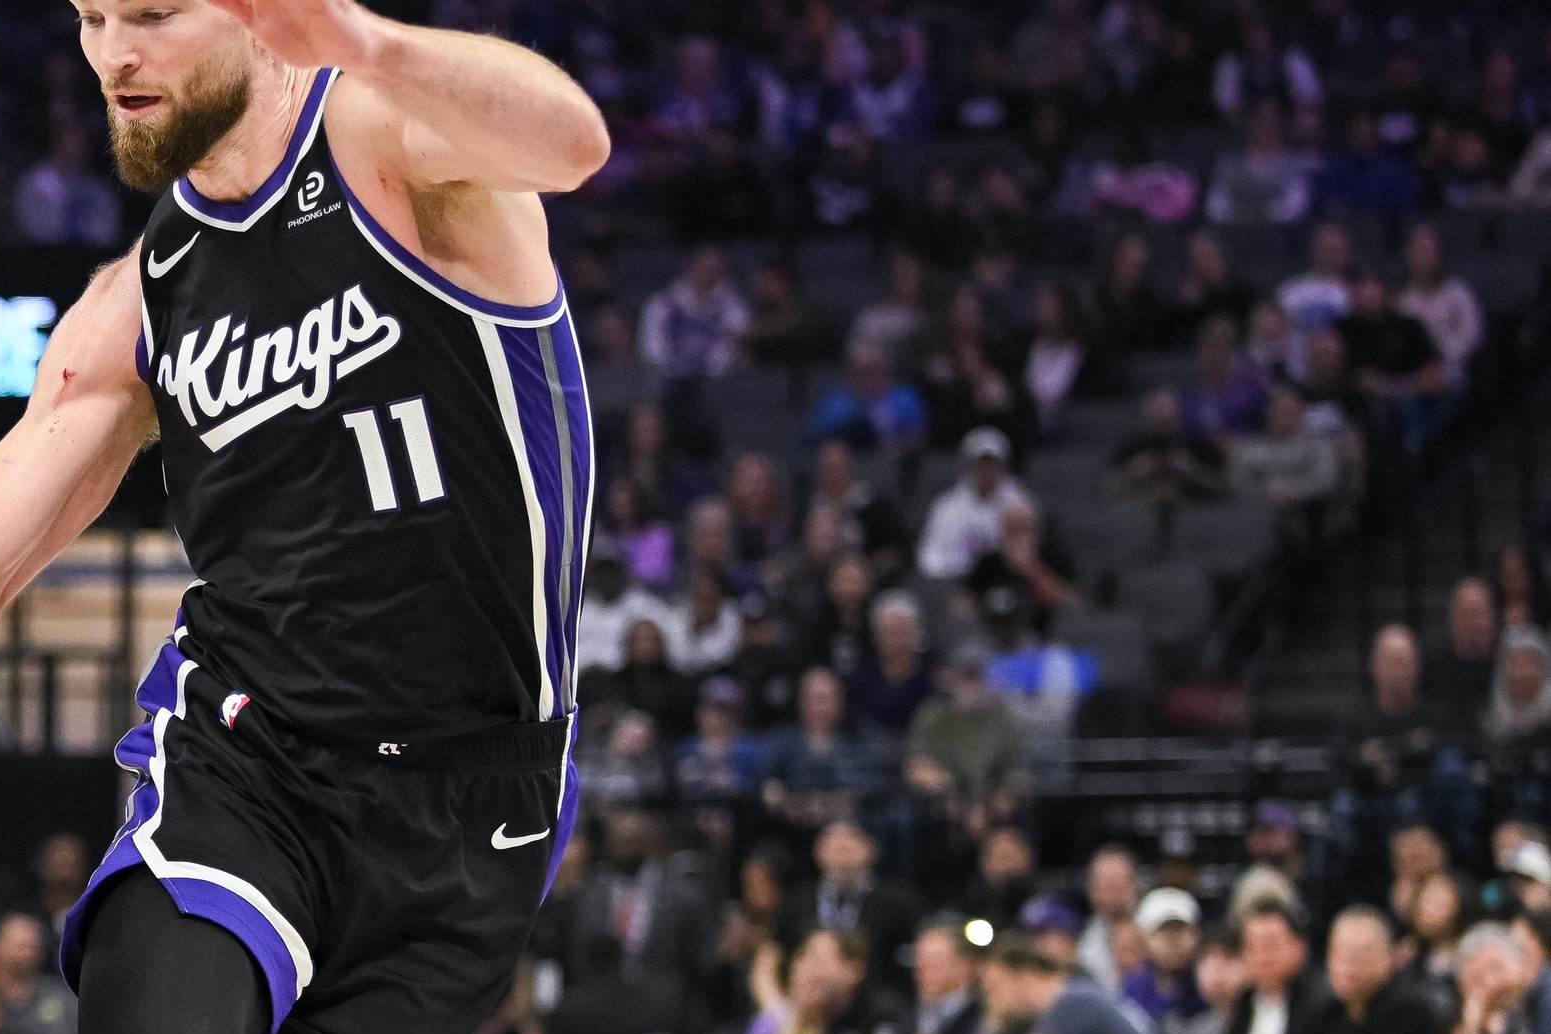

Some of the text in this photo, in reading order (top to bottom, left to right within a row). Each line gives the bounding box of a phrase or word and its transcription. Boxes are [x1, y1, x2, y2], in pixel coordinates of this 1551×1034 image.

[287, 201, 342, 229] PHOONG LAW
[156, 283, 401, 452] Kings
[342, 395, 446, 512] 11
